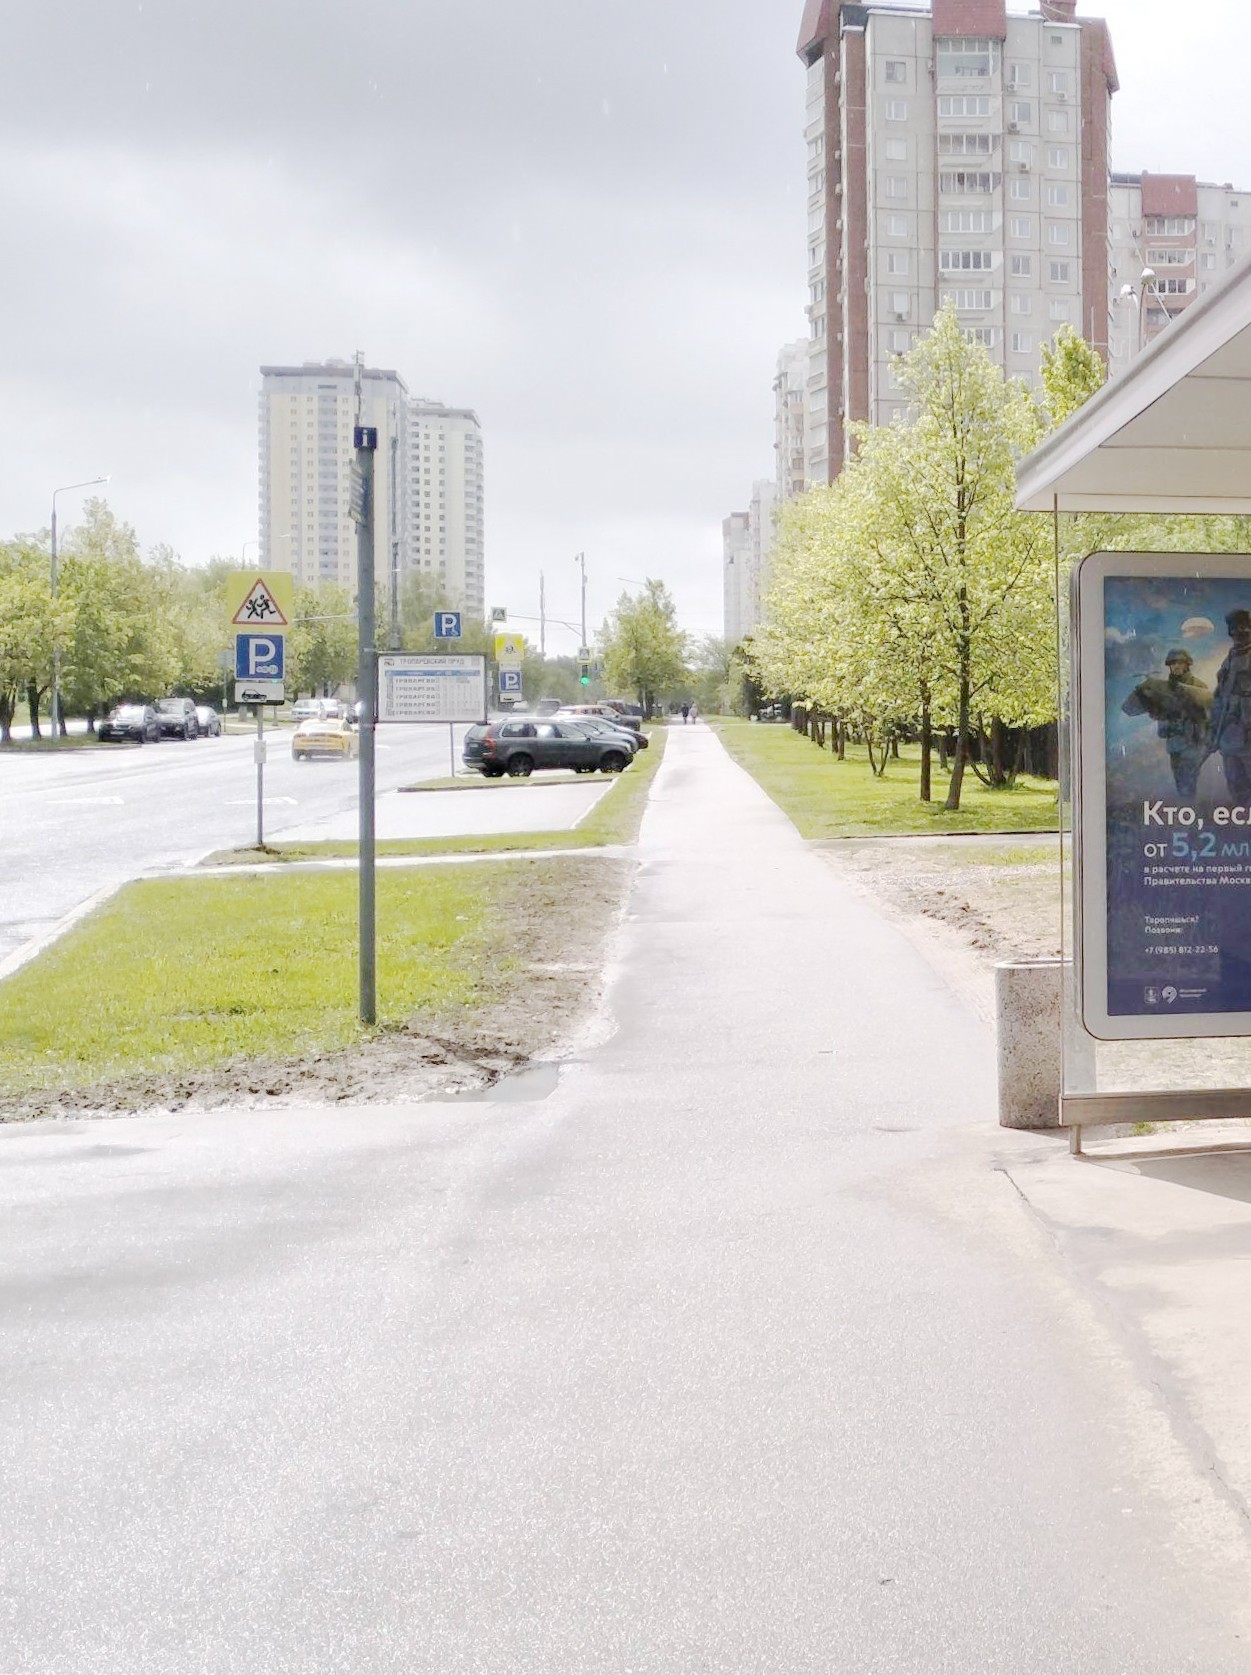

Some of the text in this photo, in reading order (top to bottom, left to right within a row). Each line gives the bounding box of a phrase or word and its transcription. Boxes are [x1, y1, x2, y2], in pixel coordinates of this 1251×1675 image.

[249, 638, 276, 675] P
[1143, 800, 1204, 830] Кто,
[1172, 832, 1217, 862] 5,2
[1143, 876, 1217, 886] Правительства
[1152, 865, 1190, 874] расчете
[1192, 864, 1204, 873] на
[1206, 864, 1243, 874] первый
